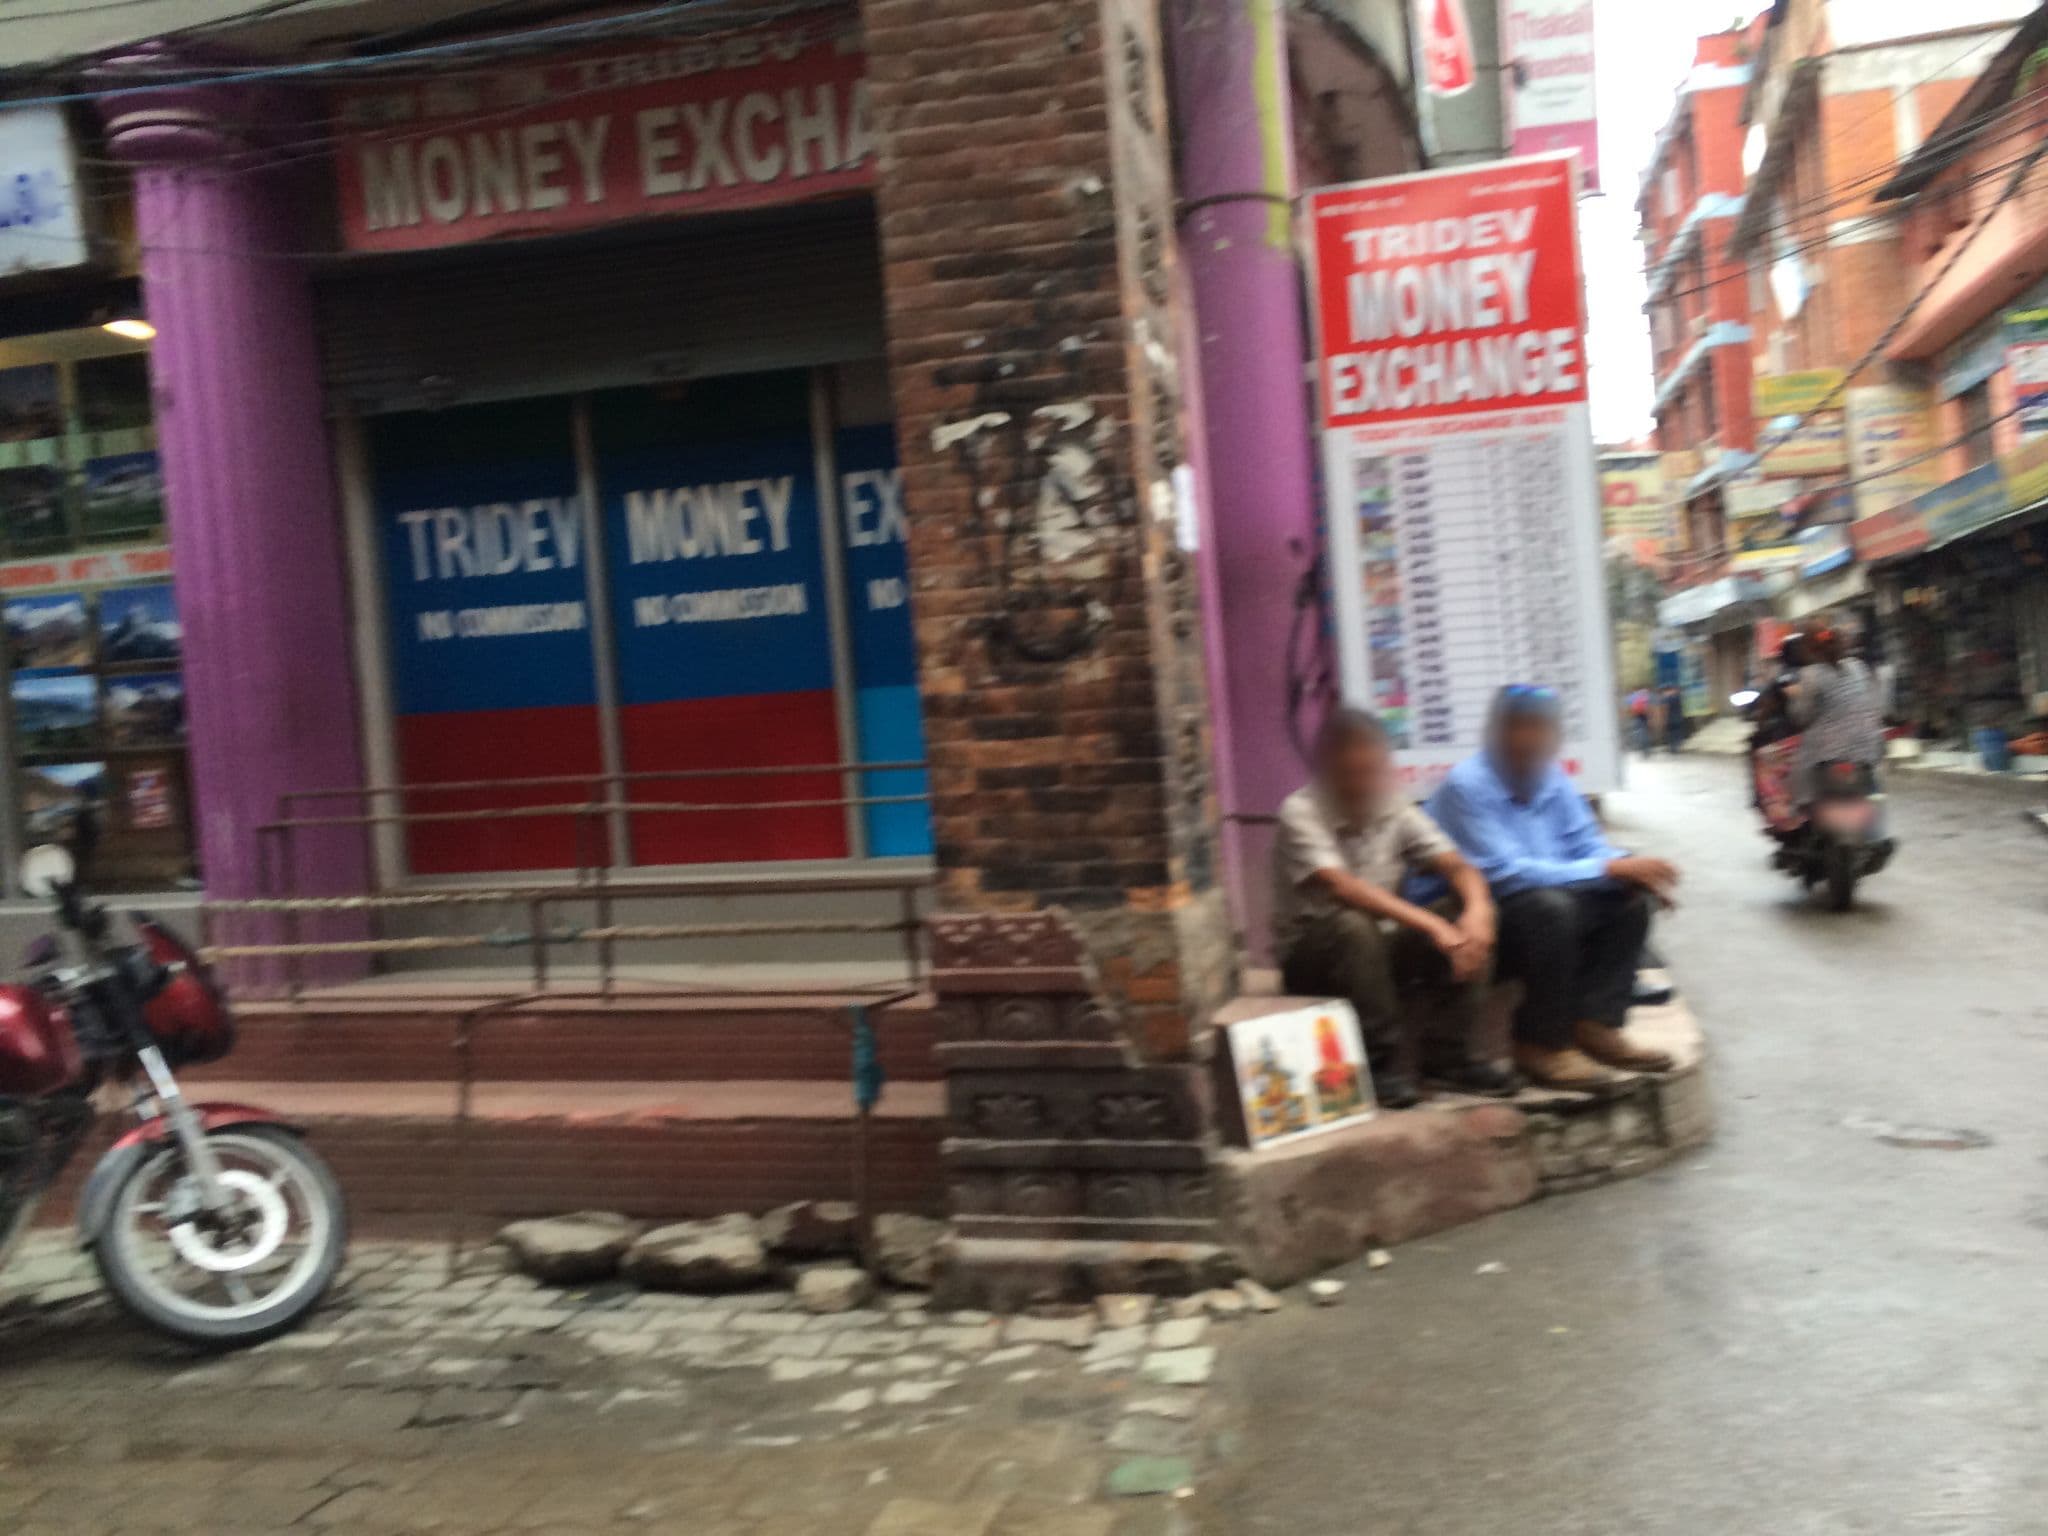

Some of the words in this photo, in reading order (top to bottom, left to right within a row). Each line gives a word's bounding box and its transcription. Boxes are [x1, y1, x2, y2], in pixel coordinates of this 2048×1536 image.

[359, 113, 610, 232] MONEY
[1342, 204, 1537, 264] TRIDEV
[1345, 249, 1538, 344] MONEY
[1326, 327, 1580, 417] EXCHANGE
[399, 499, 582, 581] TRIDEV
[623, 476, 794, 565] MONEY
